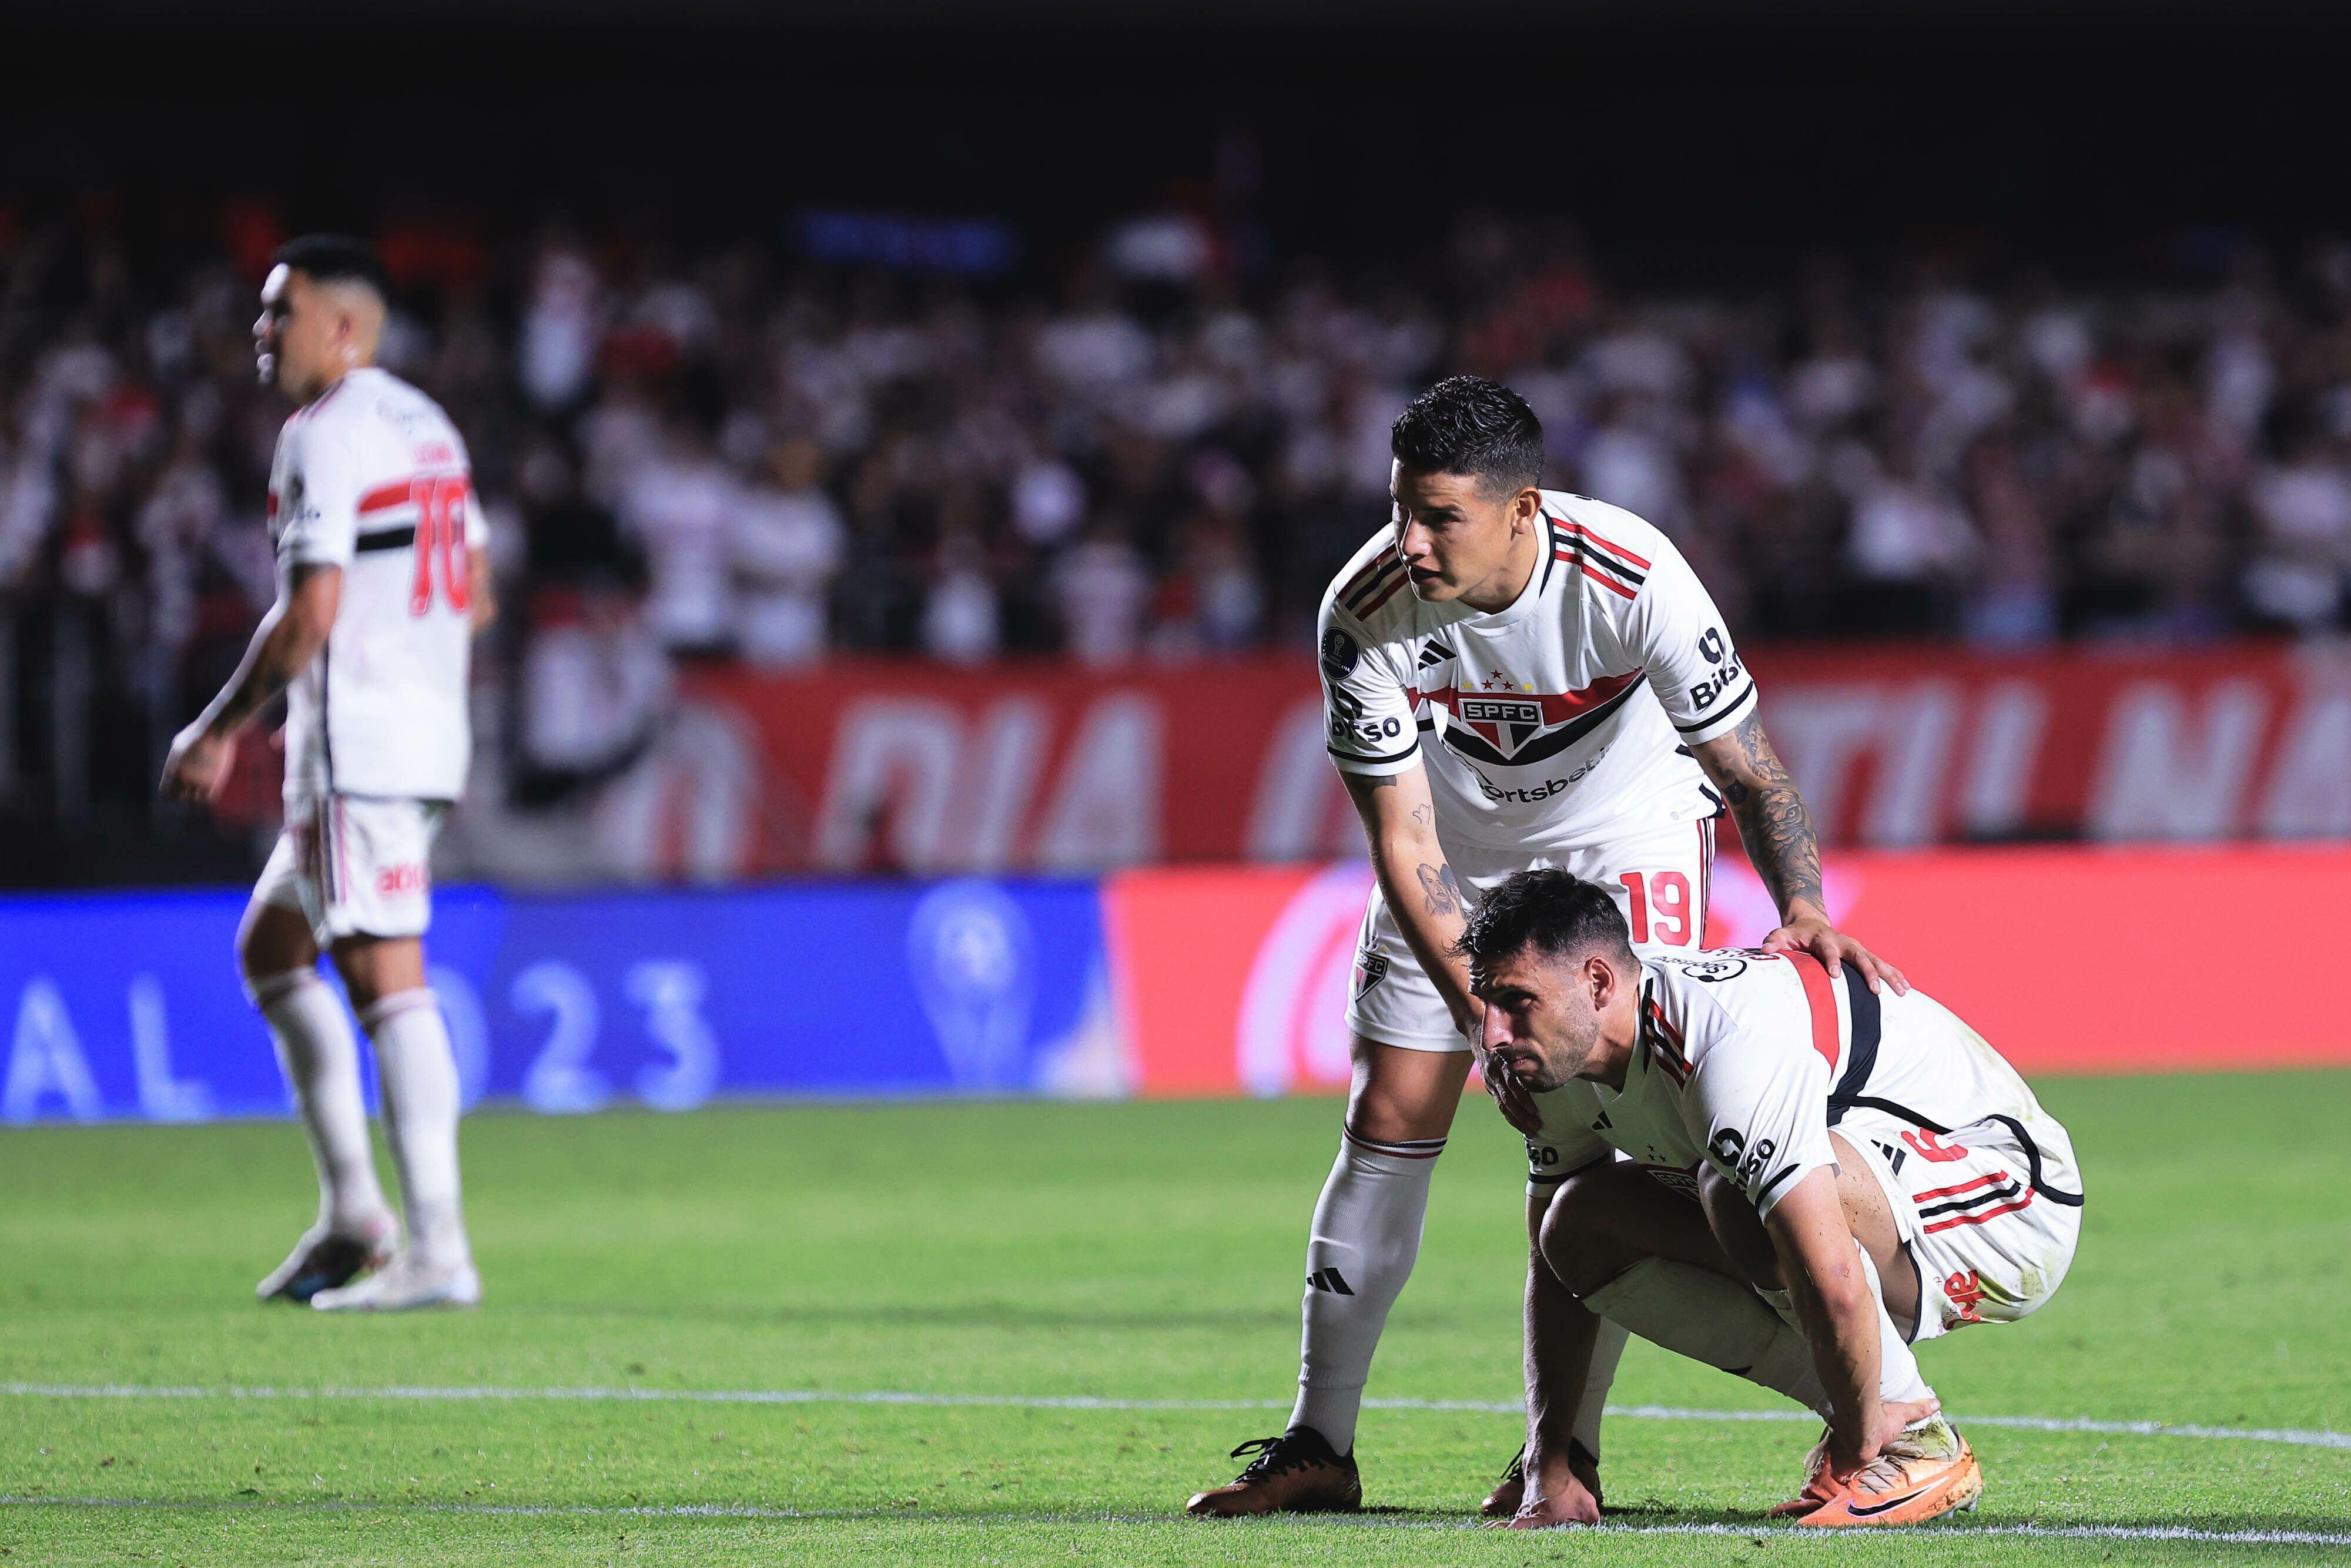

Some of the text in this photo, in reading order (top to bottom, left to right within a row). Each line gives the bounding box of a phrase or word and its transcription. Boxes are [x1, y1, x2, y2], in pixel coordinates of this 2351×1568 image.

[1467, 704, 1536, 721] SPFC
[1620, 872, 1691, 946] 19
[1358, 952, 1384, 972] SPFC
